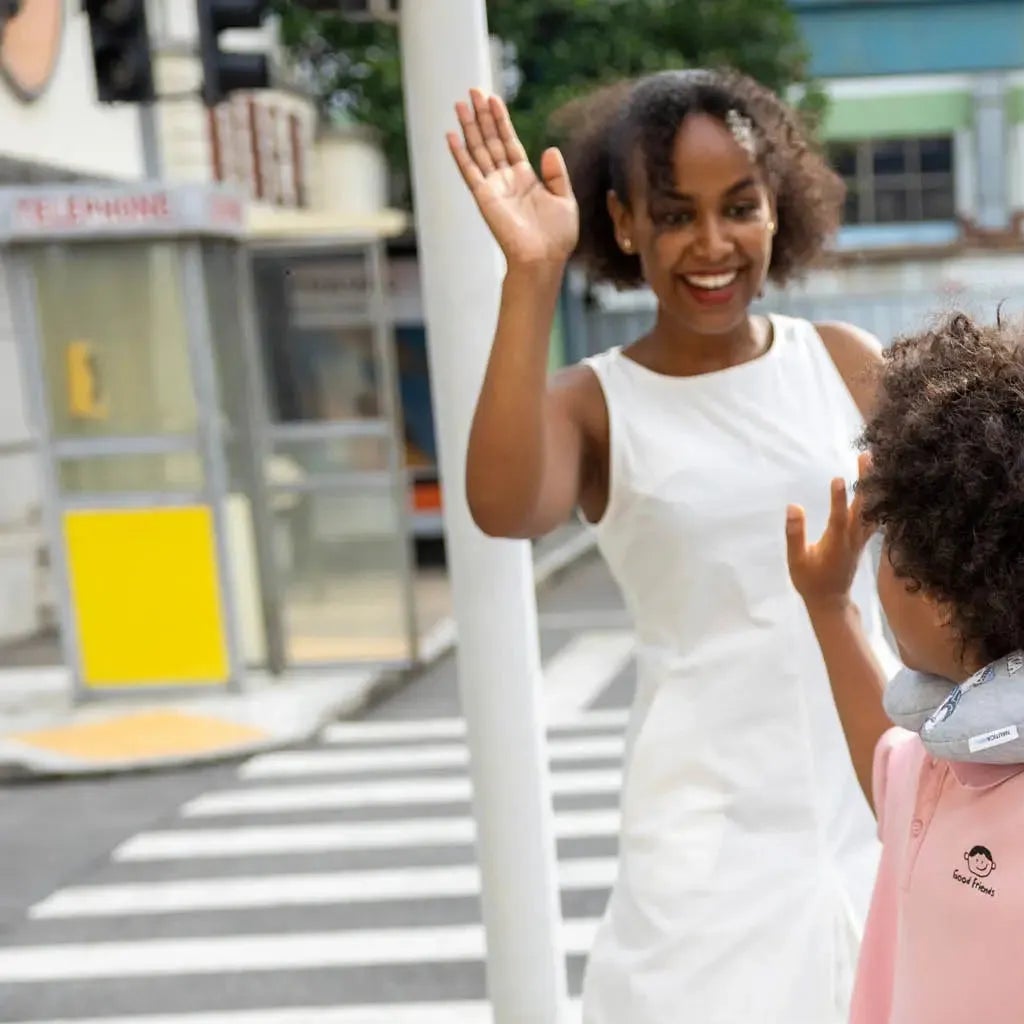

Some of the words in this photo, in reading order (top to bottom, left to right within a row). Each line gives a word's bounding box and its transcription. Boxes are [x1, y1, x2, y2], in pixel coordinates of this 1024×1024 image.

[17, 191, 169, 226] TELEPHONE
[987, 730, 1011, 742] NAUTICA
[953, 869, 971, 885] Good
